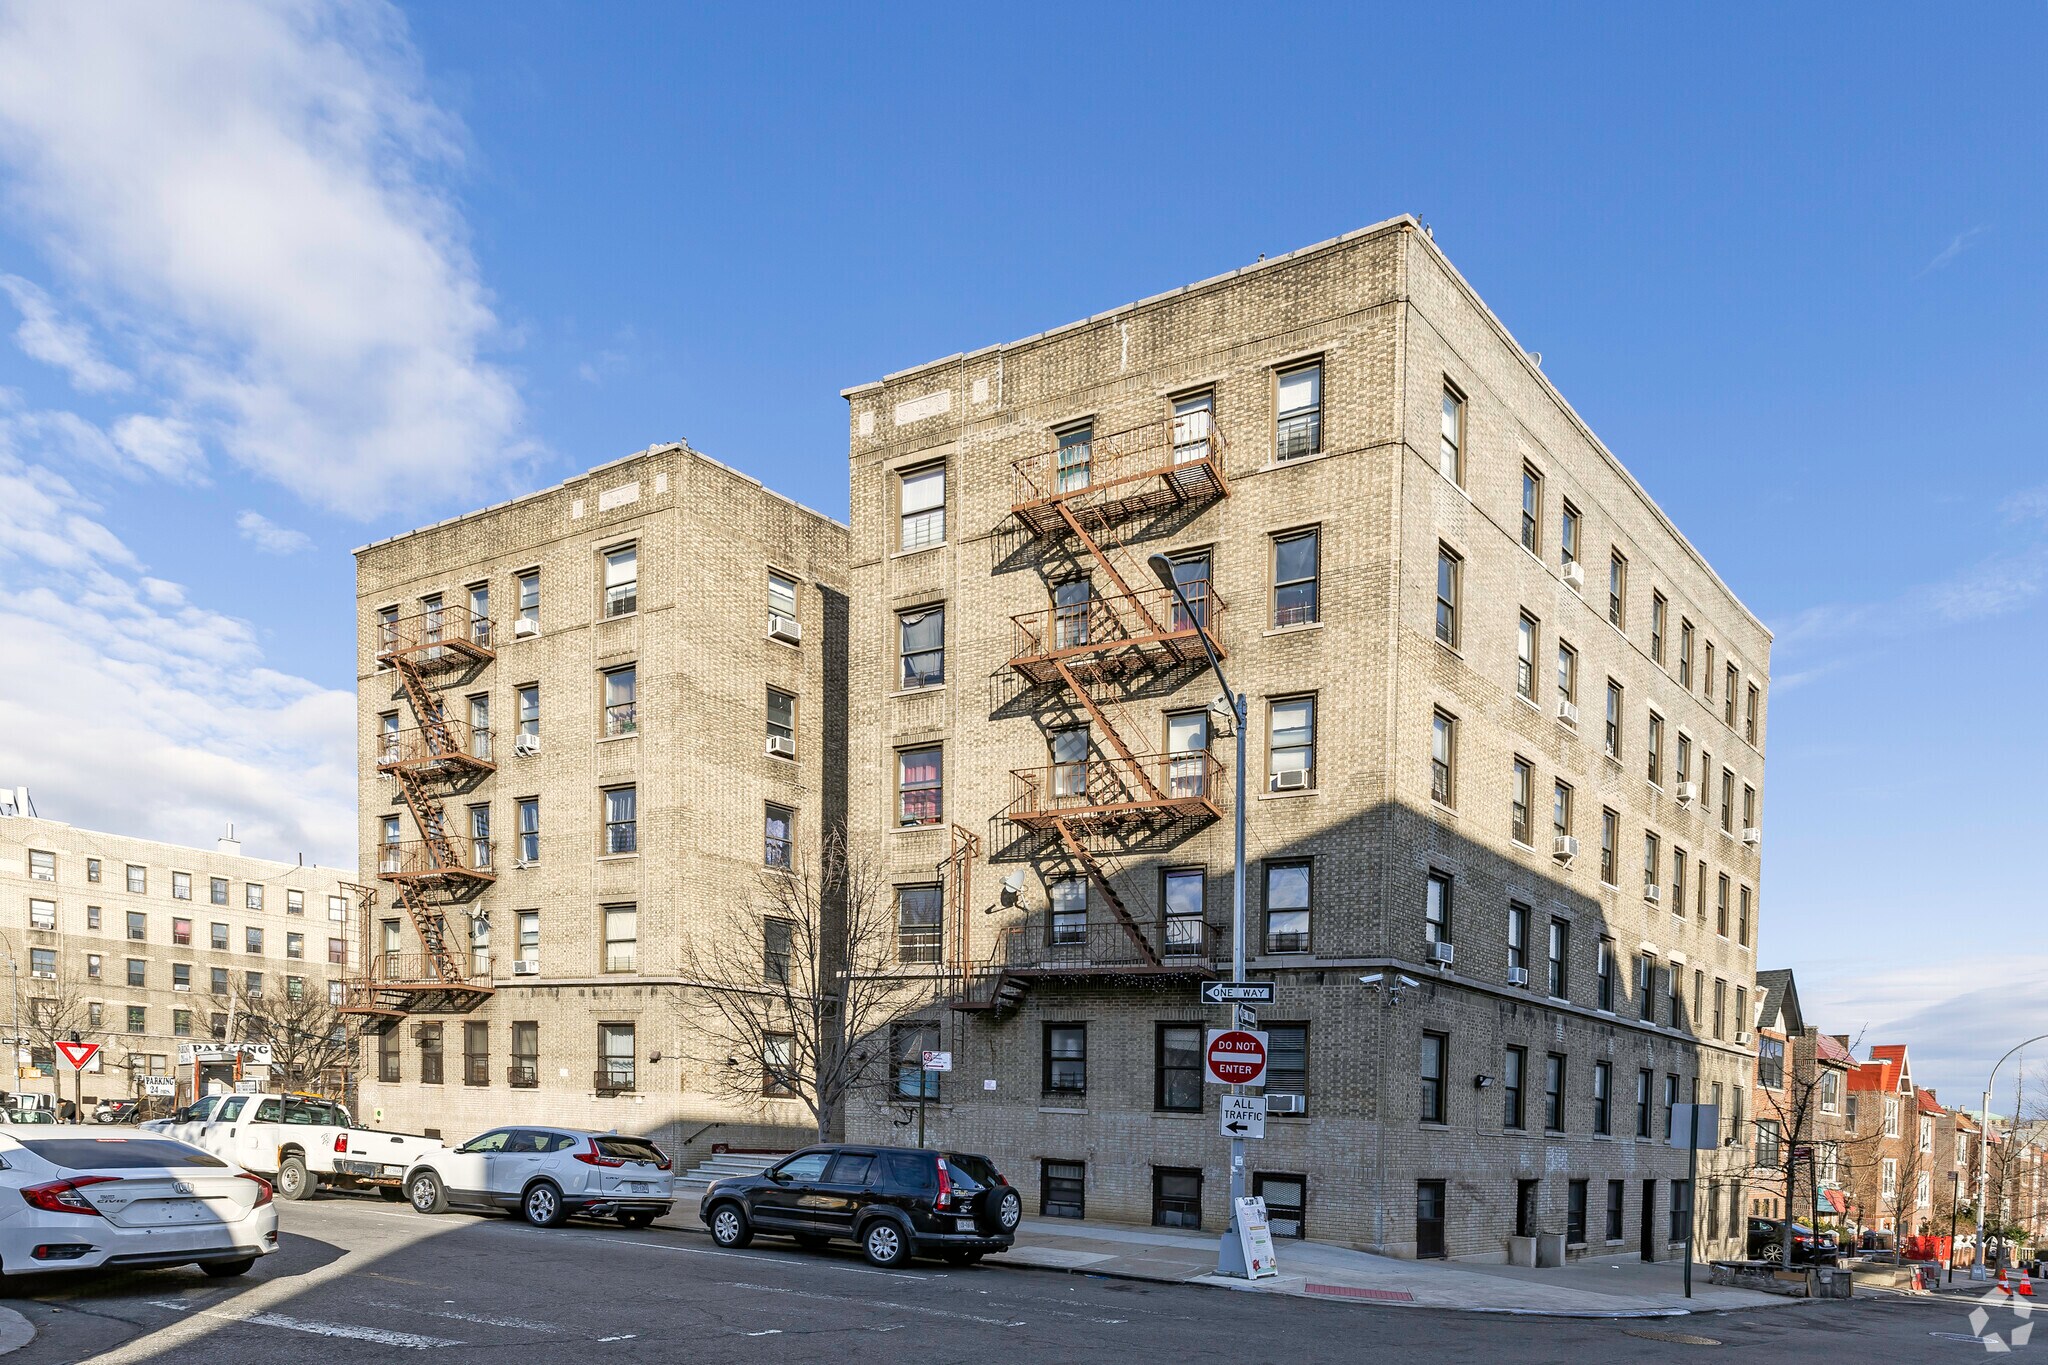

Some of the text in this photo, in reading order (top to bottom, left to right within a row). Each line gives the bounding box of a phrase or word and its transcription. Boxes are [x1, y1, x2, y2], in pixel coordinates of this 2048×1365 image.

[1213, 988, 1265, 997] ONE WAY
[1218, 1040, 1256, 1051] DO NOT
[1219, 1064, 1252, 1075] ENTER
[145, 1076, 174, 1086] PARKING
[150, 1085, 159, 1094] 24
[1233, 1099, 1254, 1110] ALL
[1224, 1109, 1263, 1122] TRAFFIC
